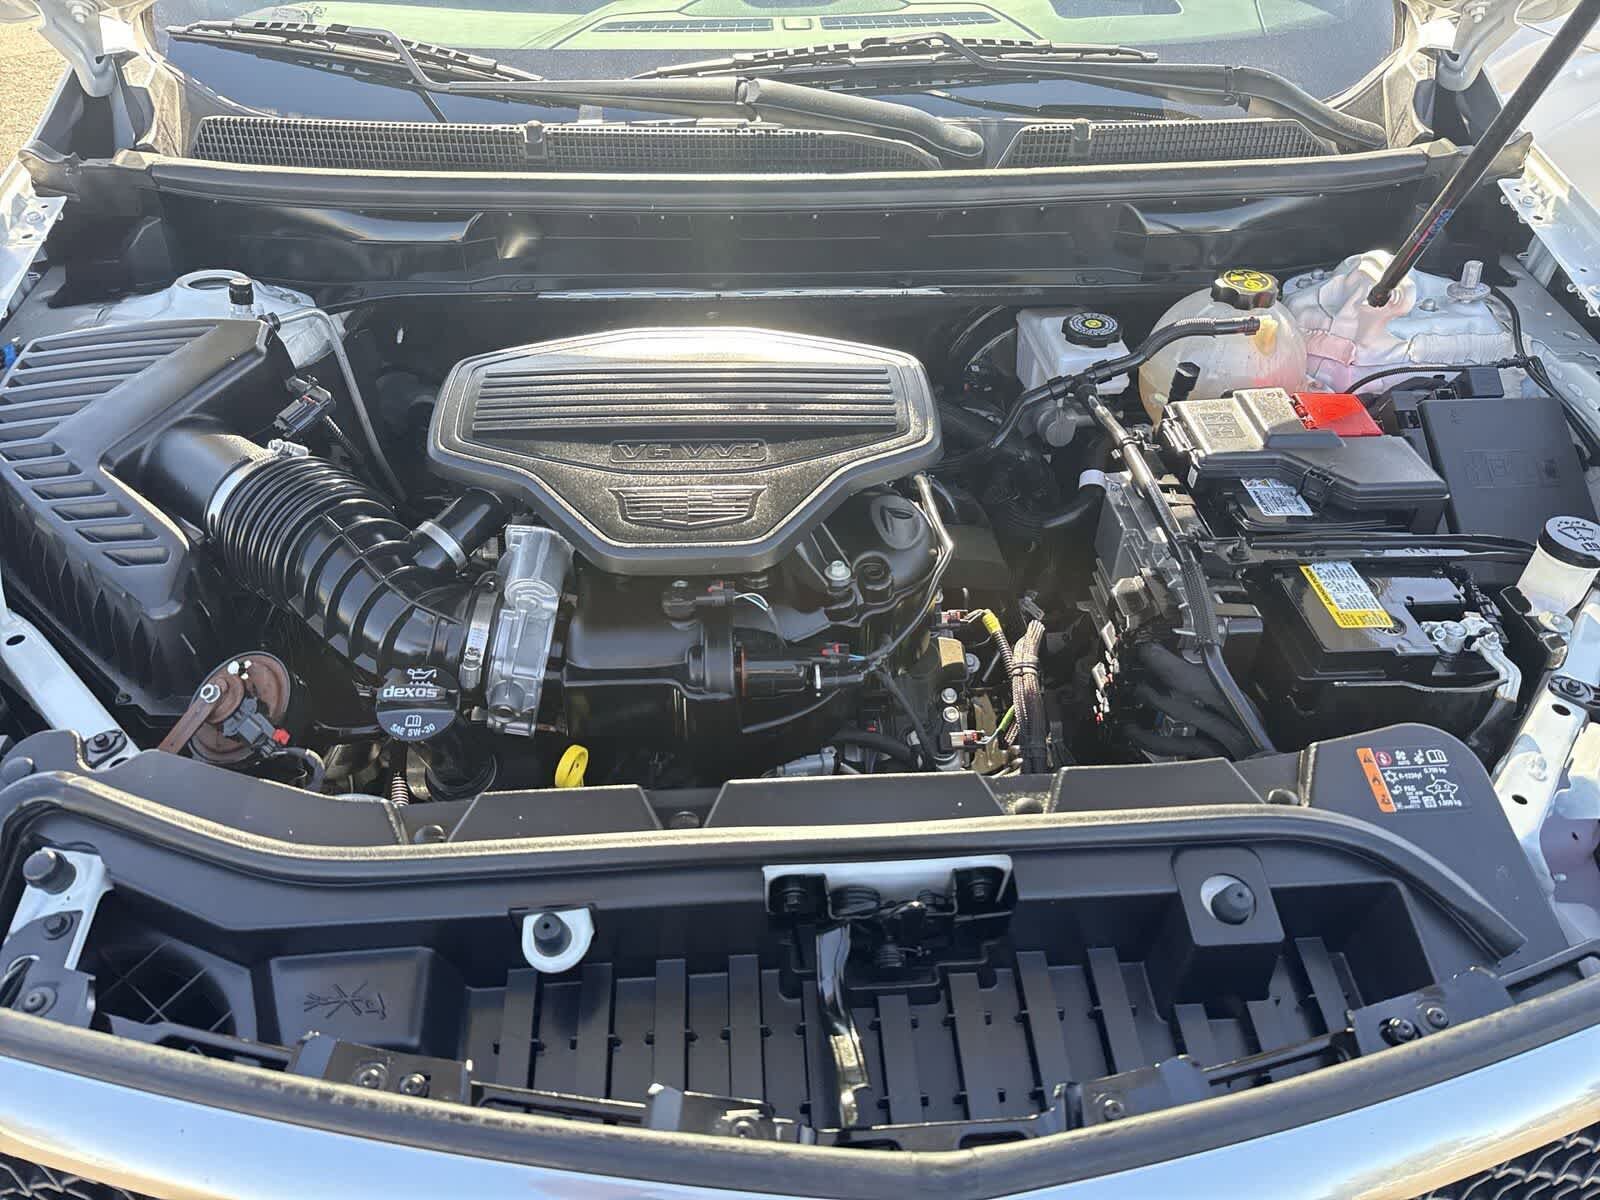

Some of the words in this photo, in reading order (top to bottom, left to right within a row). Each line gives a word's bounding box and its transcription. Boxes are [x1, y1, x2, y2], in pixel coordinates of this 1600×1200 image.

[616, 444, 672, 459] V6
[383, 685, 440, 698] dexos
[390, 723, 406, 736] SAE
[407, 723, 436, 737] 5W-30
